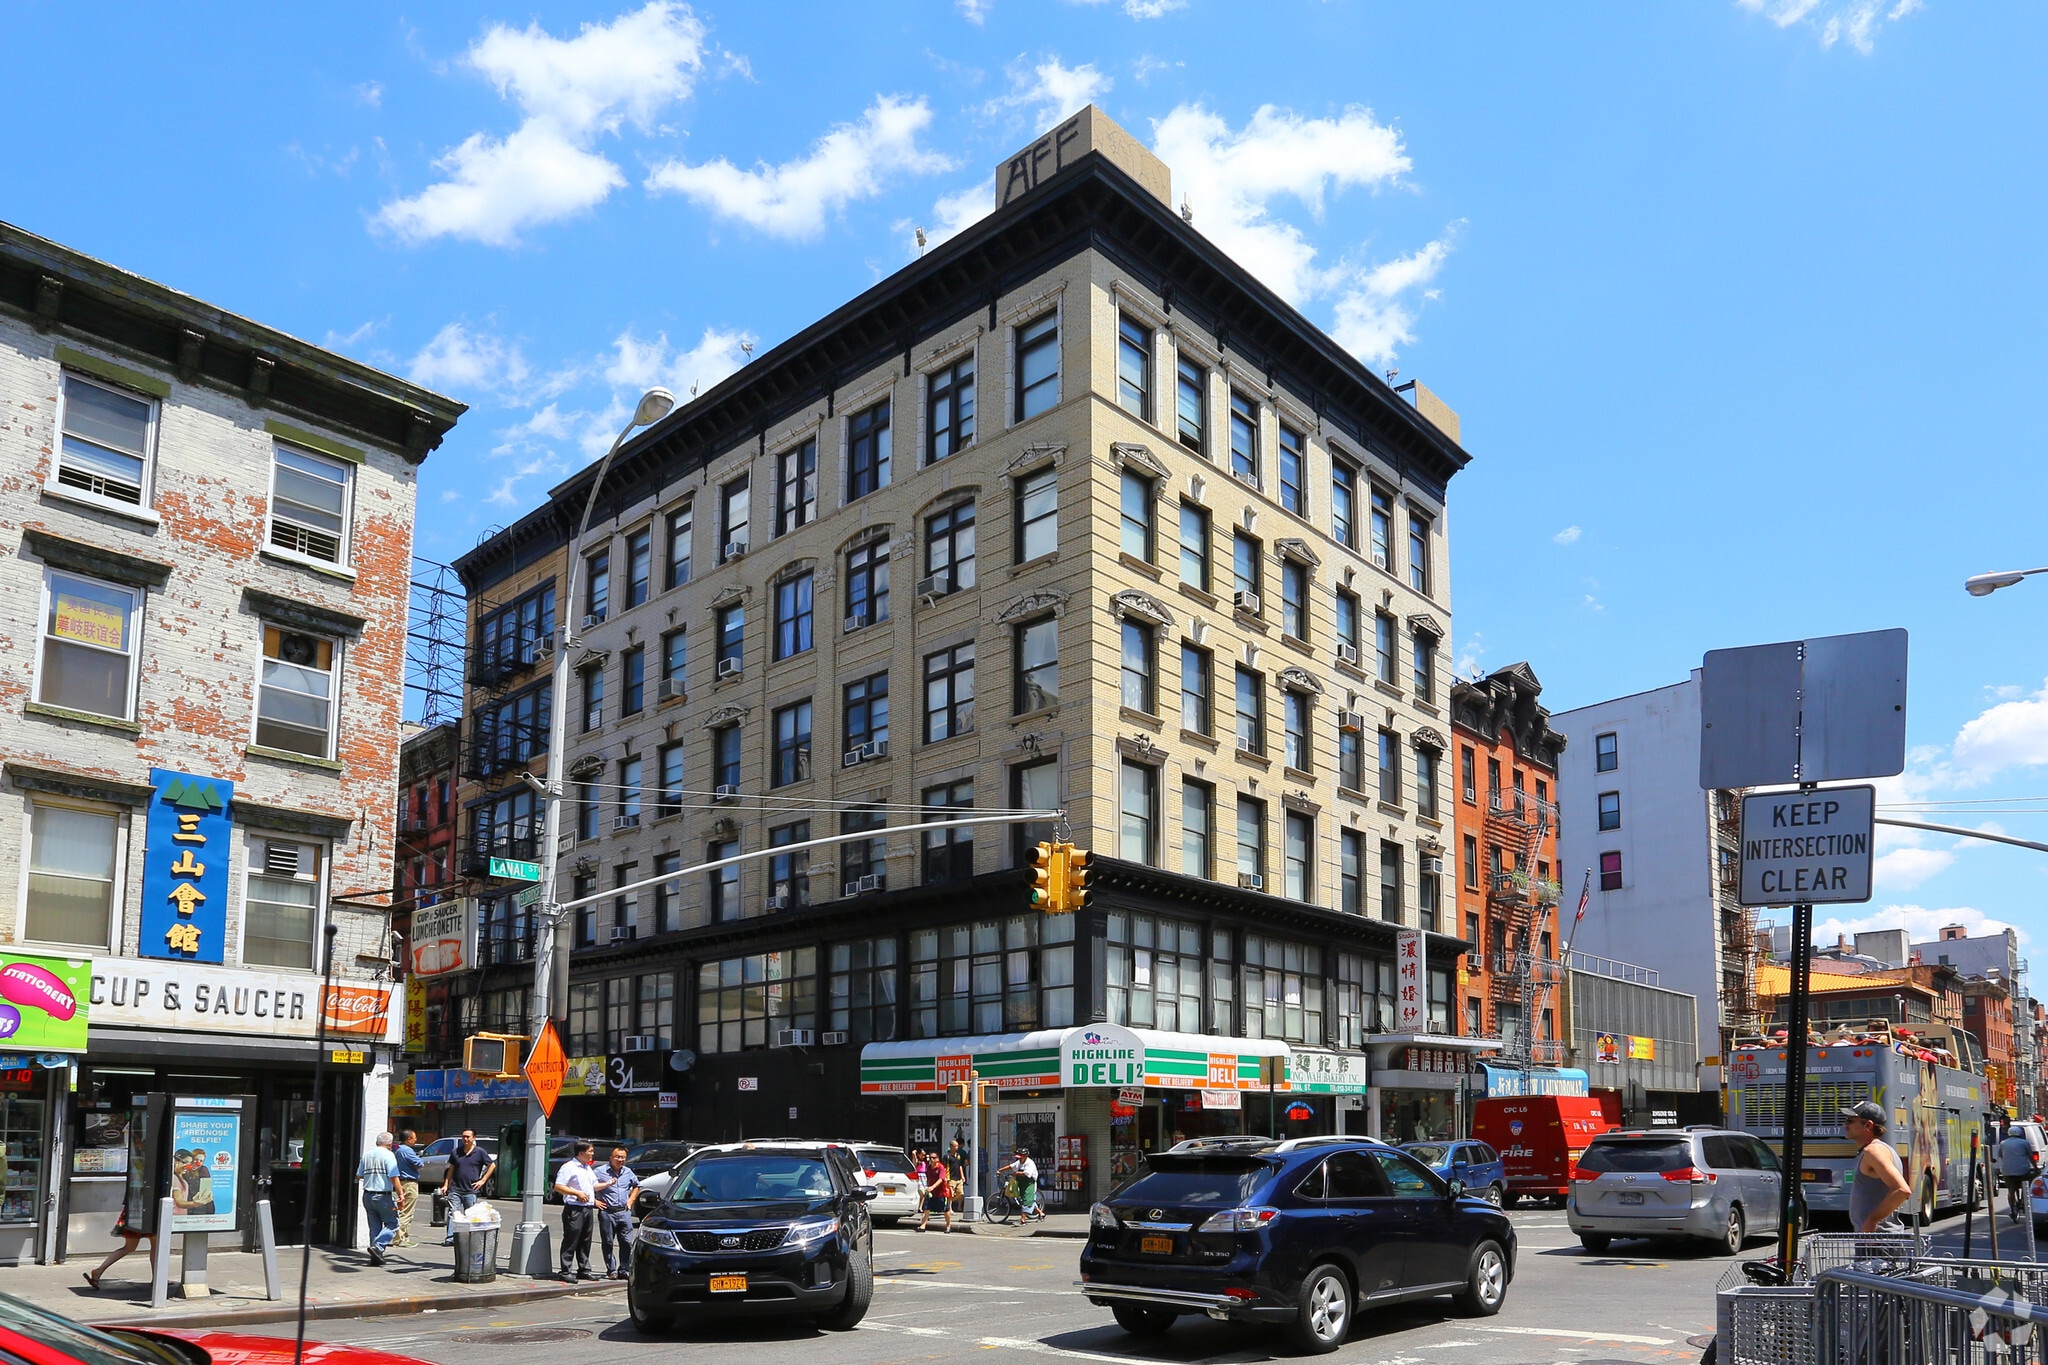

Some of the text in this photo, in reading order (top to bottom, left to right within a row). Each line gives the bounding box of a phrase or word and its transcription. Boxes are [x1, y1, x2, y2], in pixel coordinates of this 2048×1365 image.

[1002, 117, 1079, 206] AFF
[1772, 800, 1840, 828] KEEP
[1746, 833, 1866, 861] INTERSECTION
[493, 860, 538, 878] CANAL ST
[165, 814, 207, 952] 三山會館
[1761, 866, 1848, 893] CLEAR
[417, 911, 429, 923] CUP
[434, 904, 458, 920] SAUCER
[412, 915, 462, 942] LUNCHEONETTE
[3, 968, 75, 1010] STATIONERY
[89, 975, 305, 1019] CUP & SAUCER
[1072, 1049, 1135, 1060] HIGHLINE
[1210, 1057, 1236, 1065] HIGHLINE
[938, 1059, 970, 1067] HIGHLINE
[938, 1069, 970, 1085] DELI
[1160, 1078, 1194, 1086] FREE DELIVERY
[1210, 1067, 1235, 1084] DELI
[1306, 1072, 1321, 1082] WAH
[1324, 1073, 1345, 1083] BAKERY
[540, 1079, 557, 1091] AHEAD
[892, 1083, 916, 1091] DELIVERY
[1541, 1079, 1582, 1097] LAUNDROMAT
[194, 1097, 226, 1106] TITAN
[1121, 1091, 1142, 1100] ATM
[180, 1121, 233, 1129] SHARE YOUR
[1018, 1113, 1054, 1124] LINKIN PARK
[184, 1129, 229, 1137] #REDNOSE
[914, 1128, 938, 1142] BLK
[1833, 1127, 1841, 1135] 17
[1500, 1149, 1534, 1157] FIRE
